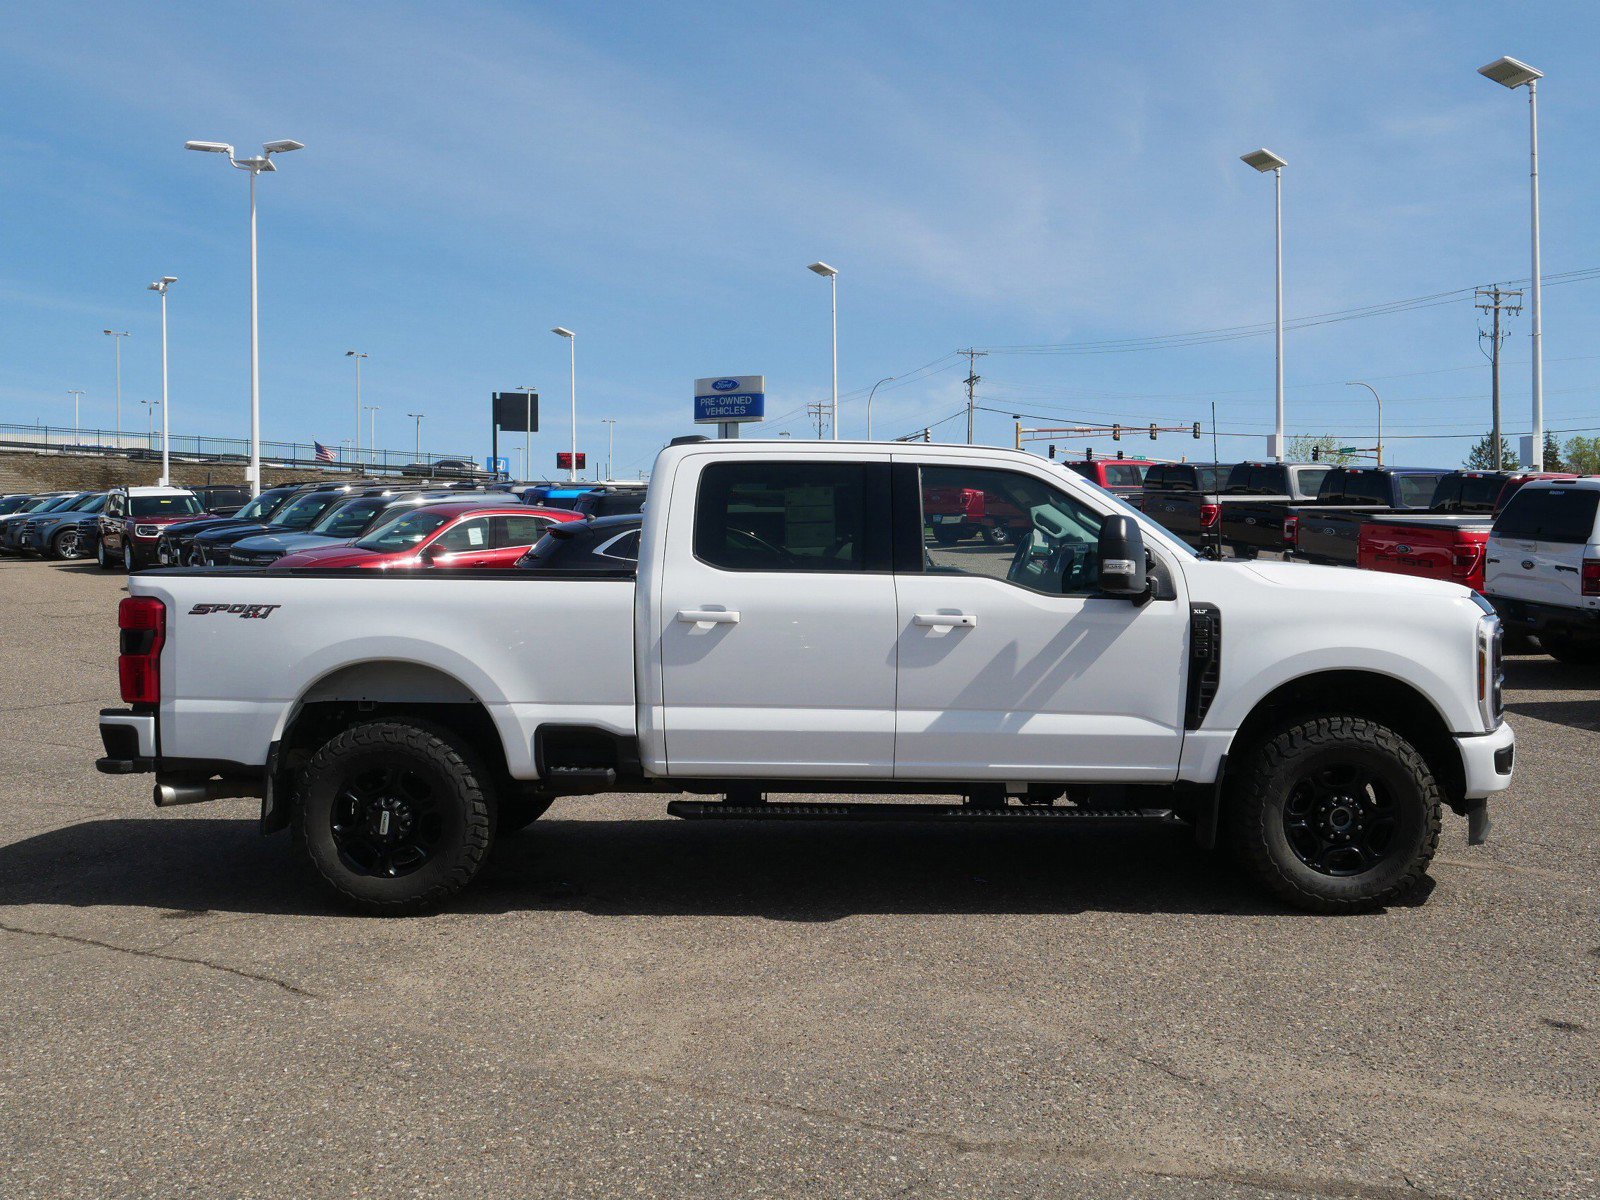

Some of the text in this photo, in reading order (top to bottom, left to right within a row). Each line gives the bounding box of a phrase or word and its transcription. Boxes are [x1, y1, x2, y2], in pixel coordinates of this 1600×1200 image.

[715, 380, 733, 389] Ford
[705, 406, 746, 416] VEHICLES
[188, 603, 281, 616] SPORT
